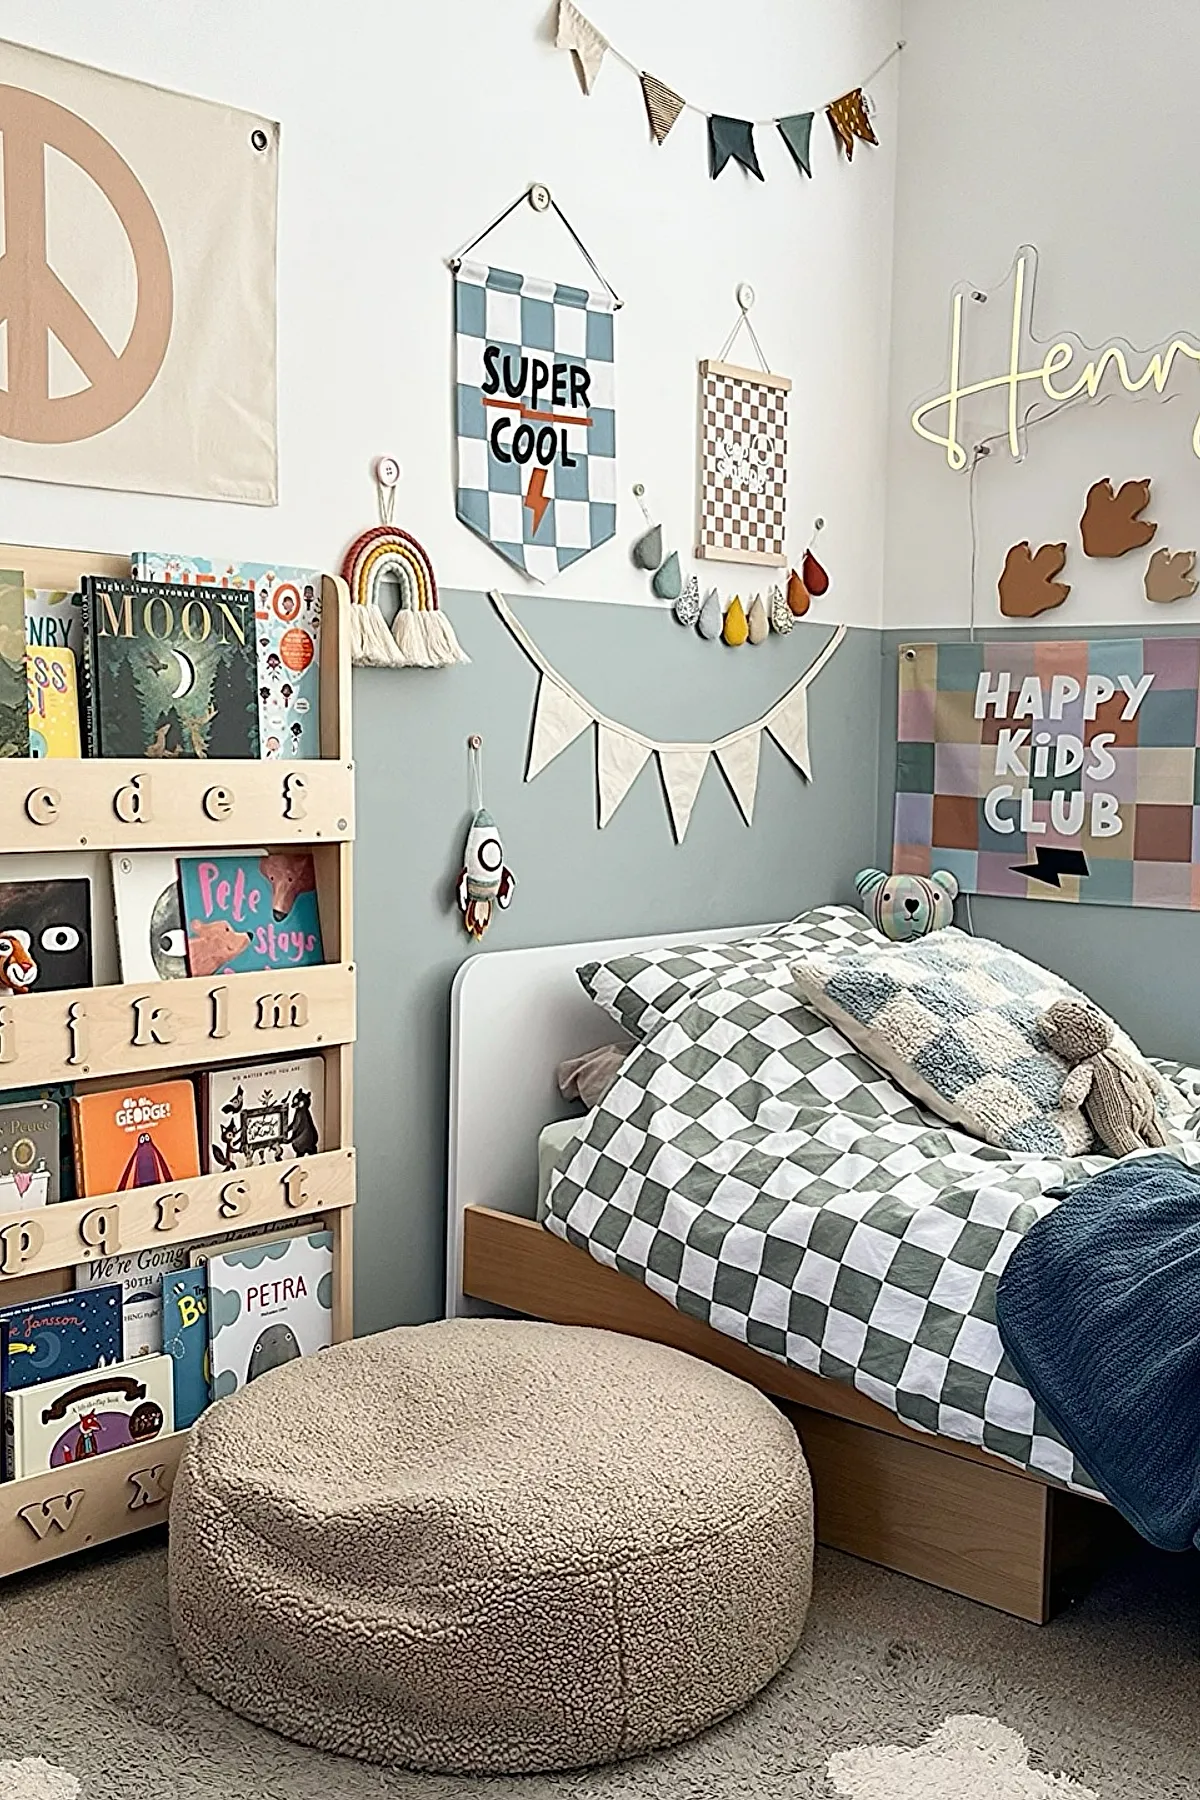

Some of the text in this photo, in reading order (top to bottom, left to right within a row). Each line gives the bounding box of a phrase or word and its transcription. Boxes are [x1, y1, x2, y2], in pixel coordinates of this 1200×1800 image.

[481, 345, 591, 410] SUPER
[911, 257, 1200, 470] Henr
[490, 416, 577, 468] COOL
[95, 592, 250, 647] MOON
[158, 588, 196, 599] around
[200, 590, 217, 600] the
[220, 592, 249, 603] world
[973, 671, 1156, 722] HAPPY
[113, 773, 153, 824] d
[202, 785, 235, 822] e
[282, 771, 309, 821] f
[982, 784, 1125, 837] CLUB
[198, 862, 261, 922] Pete
[131, 996, 176, 1047] k
[255, 992, 309, 1030] m
[115, 1102, 171, 1127] GEORGE!
[0, 1164, 309, 1274] p q r s t
[89, 1257, 132, 1282] We're
[137, 1246, 185, 1271] Going
[124, 1275, 153, 1290] 30TH
[247, 1275, 308, 1312] PETRA
[22, 1313, 85, 1337] Jansson
[17, 1463, 173, 1540] w x
